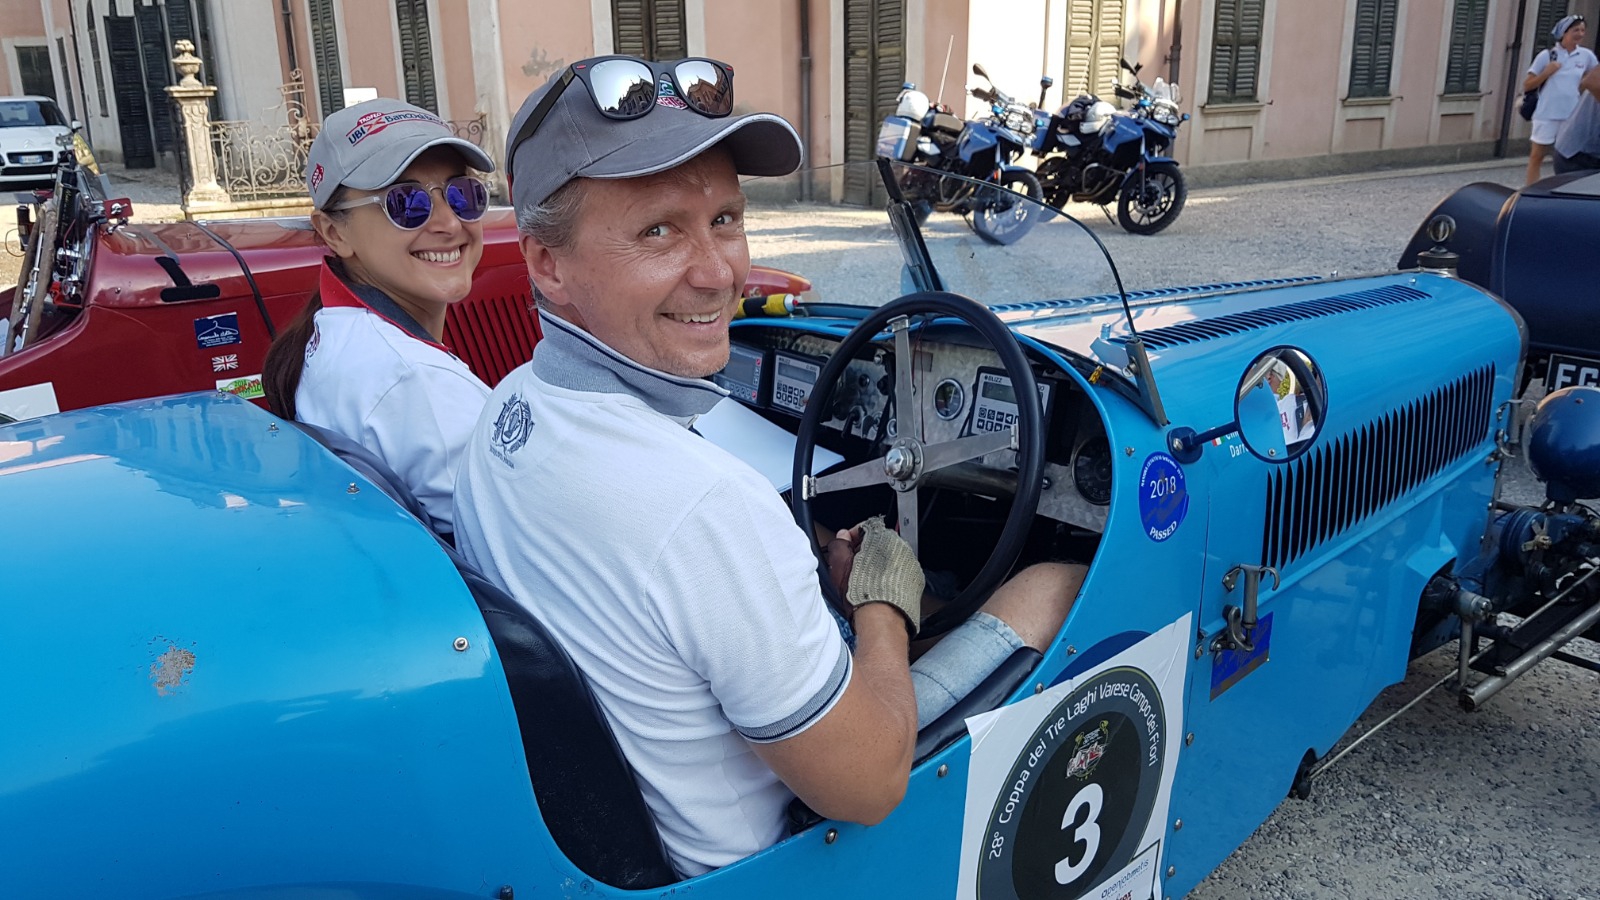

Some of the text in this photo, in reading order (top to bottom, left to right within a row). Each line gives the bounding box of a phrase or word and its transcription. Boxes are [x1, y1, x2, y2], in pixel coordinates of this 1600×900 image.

[348, 127, 366, 144] UBI
[1149, 475, 1177, 499] 2018
[1149, 521, 1177, 540] PASSED
[1066, 686, 1098, 721] Laghi
[1099, 682, 1130, 699] Varese
[1129, 683, 1152, 717] Campo
[1045, 717, 1066, 740] Tre
[1146, 713, 1159, 735] dei
[1028, 738, 1047, 768] dei
[1149, 731, 1160, 767] Fiori
[999, 769, 1030, 824] Coppa
[1054, 782, 1104, 885] 3
